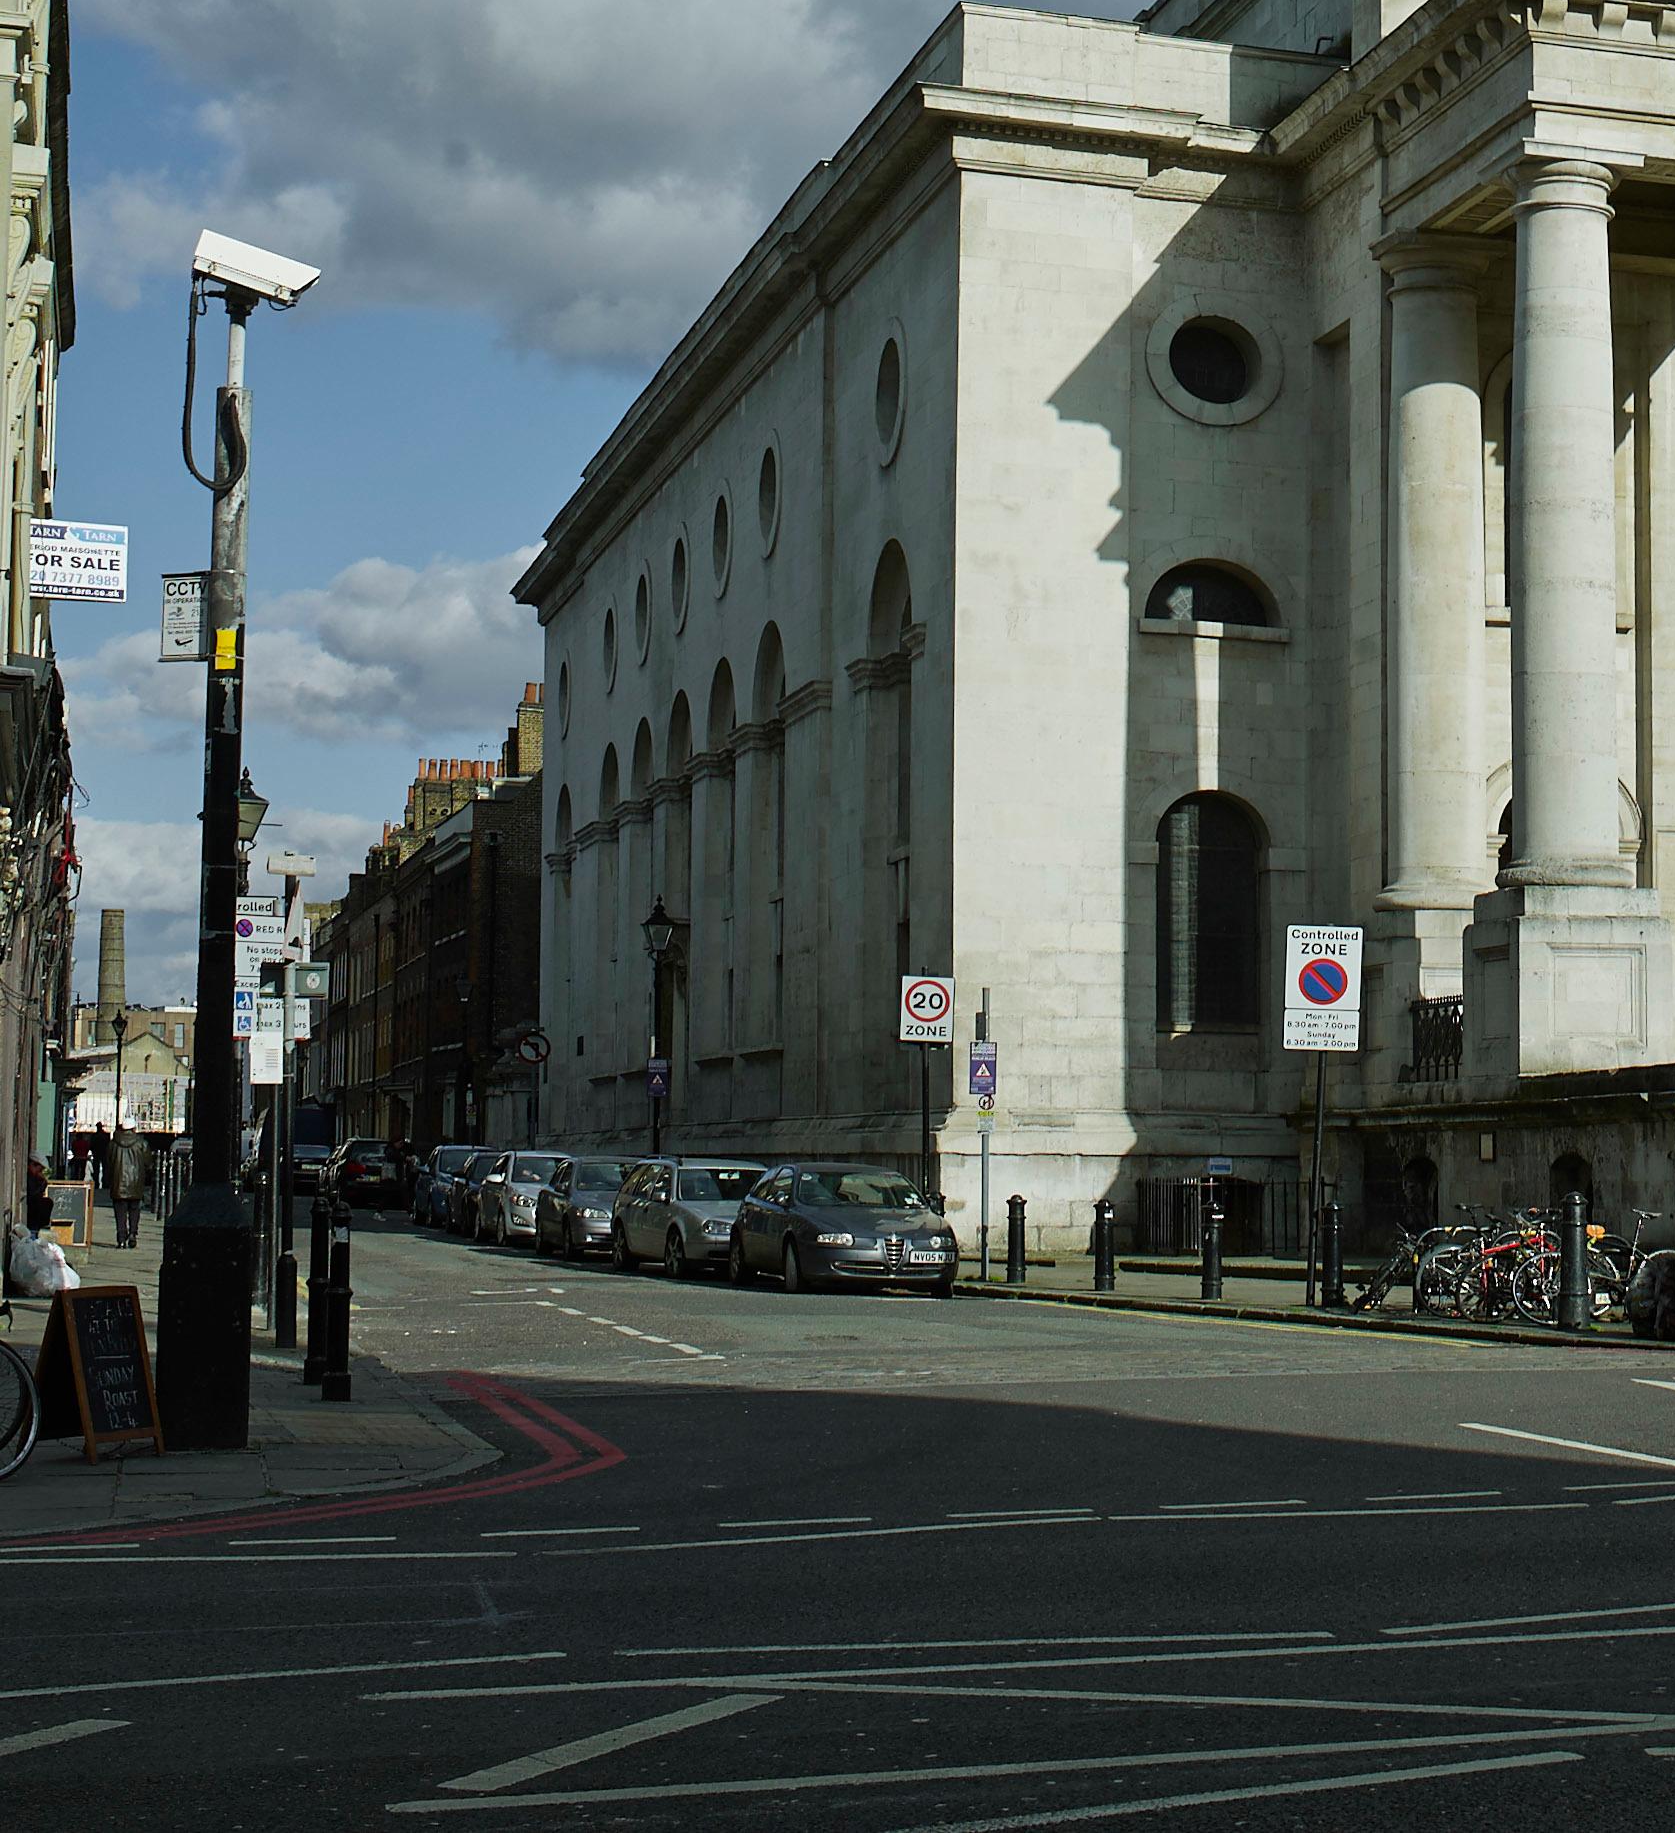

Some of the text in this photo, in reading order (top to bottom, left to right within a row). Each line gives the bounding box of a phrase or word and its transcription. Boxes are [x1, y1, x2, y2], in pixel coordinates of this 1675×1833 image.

[82, 529, 117, 542] TARN
[70, 556, 120, 571] SALE
[31, 570, 120, 587] 20 7377 8989
[166, 581, 208, 597] CCTV
[237, 901, 272, 912] rolled
[256, 925, 274, 934] RED
[1291, 929, 1359, 941] Controlled
[246, 945, 259, 954] No
[1301, 942, 1348, 956] ZONE
[235, 980, 260, 989] Excep
[912, 992, 944, 1010] 20
[1328, 1013, 1339, 1021] Fri
[905, 1024, 947, 1037] ZONE
[1307, 1031, 1336, 1039] Sunday
[1343, 1040, 1356, 1049] pm
[102, 1389, 139, 1412] ROAST
